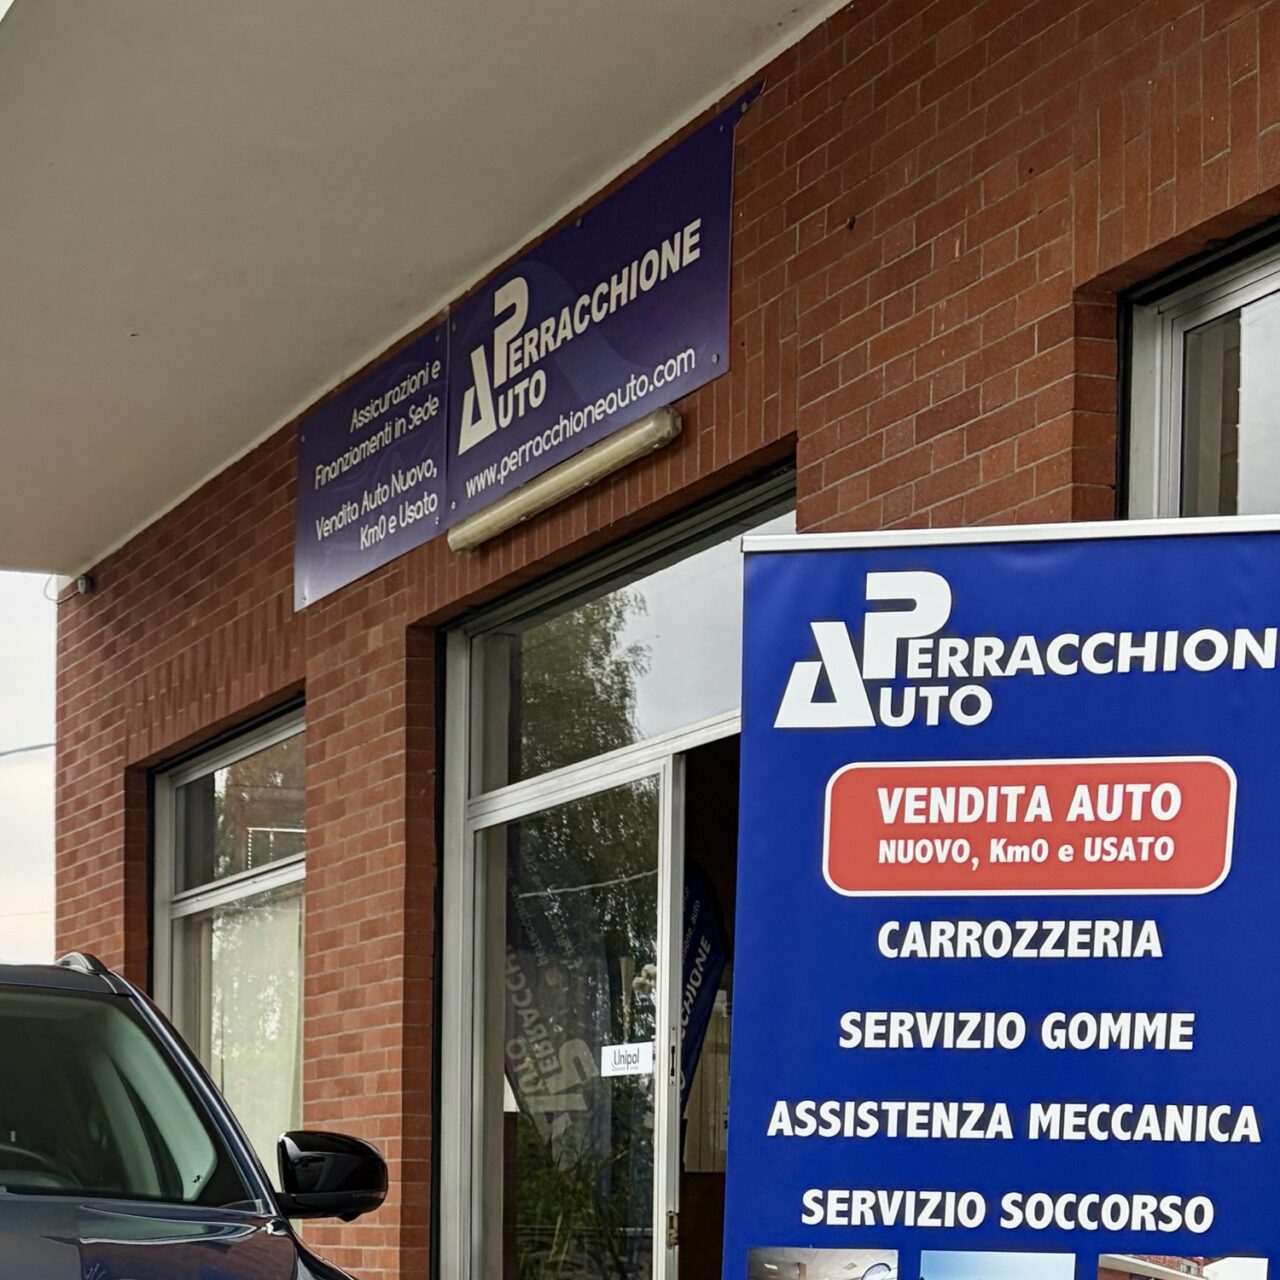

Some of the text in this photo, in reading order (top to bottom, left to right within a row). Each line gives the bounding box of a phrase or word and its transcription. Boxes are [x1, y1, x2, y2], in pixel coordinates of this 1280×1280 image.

[493, 218, 701, 389] PERRACCHIONE
[350, 360, 441, 433] Assicurazioni e
[458, 344, 547, 457] AUTO
[466, 347, 695, 499] www.perracchioneauto.com
[314, 394, 439, 490] Finanziamenti in Sede
[316, 458, 437, 541] Vendita Auto Nuovo,
[360, 491, 438, 551] Km0 e Usato
[863, 570, 1278, 679] PERRACCHION
[773, 621, 993, 728] AUTO
[877, 782, 1182, 824] VENDITA AUTO
[878, 836, 1175, 870] NUOVO, Km0 e USATO
[878, 919, 1163, 958] CARROZZERIA
[613, 1048, 640, 1070] Unipol
[839, 1011, 1195, 1050] SERVIZIO GOMME
[767, 1100, 1013, 1140] ASSISTENZA
[1029, 1103, 1261, 1143] MECCANICA
[801, 1189, 1214, 1234] SERVIZIO SOCCORSO
